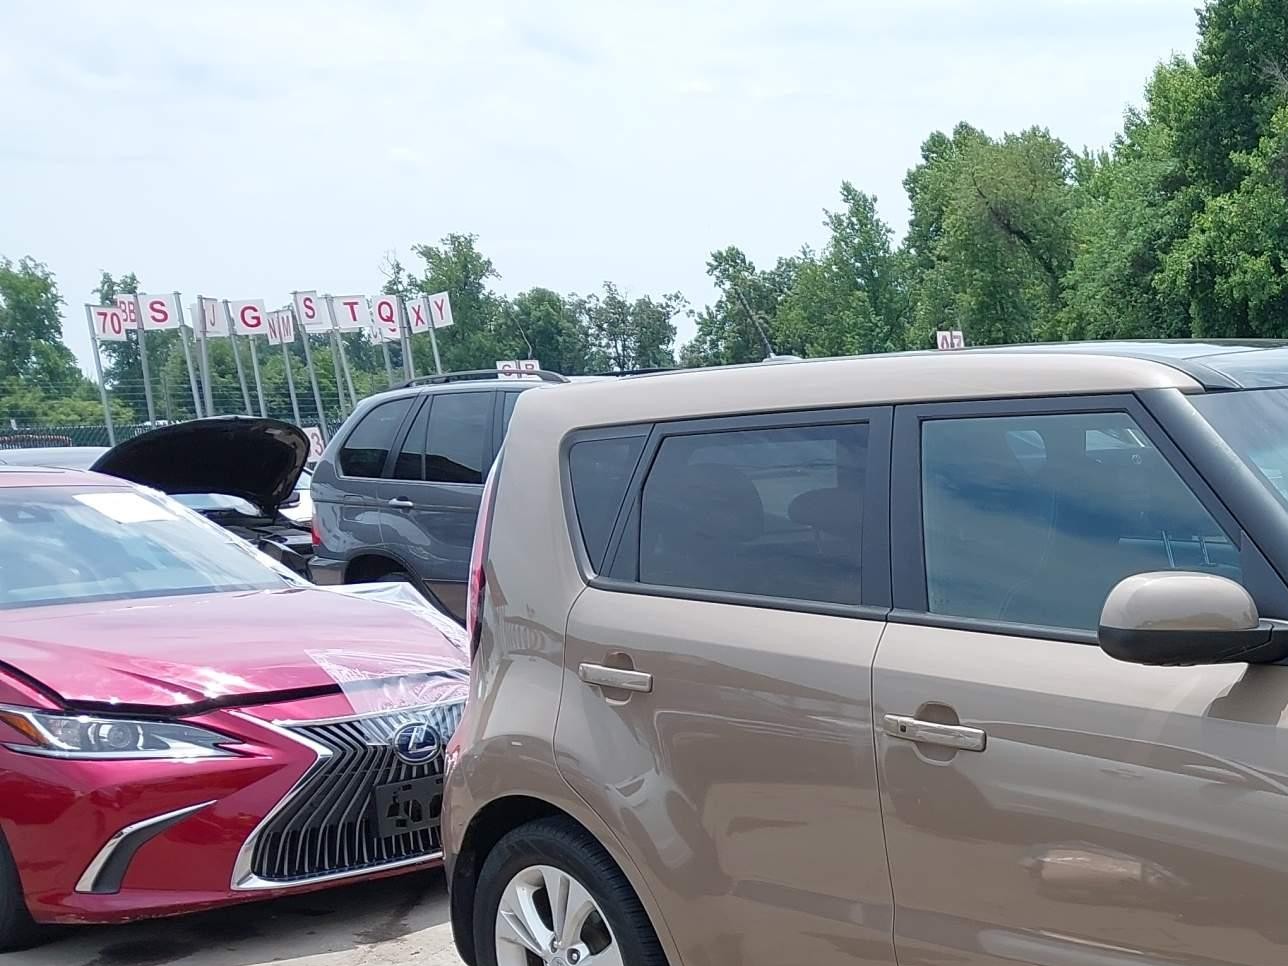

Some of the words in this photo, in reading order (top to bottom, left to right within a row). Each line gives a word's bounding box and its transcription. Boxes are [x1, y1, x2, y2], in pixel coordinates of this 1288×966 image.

[149, 300, 169, 323] S
[209, 303, 216, 327] J
[240, 305, 262, 328] G
[303, 297, 316, 320] S
[343, 301, 359, 322] T
[378, 301, 395, 323] Q
[411, 304, 426, 327] X
[434, 298, 444, 321] Y
[96, 311, 122, 335] 70
